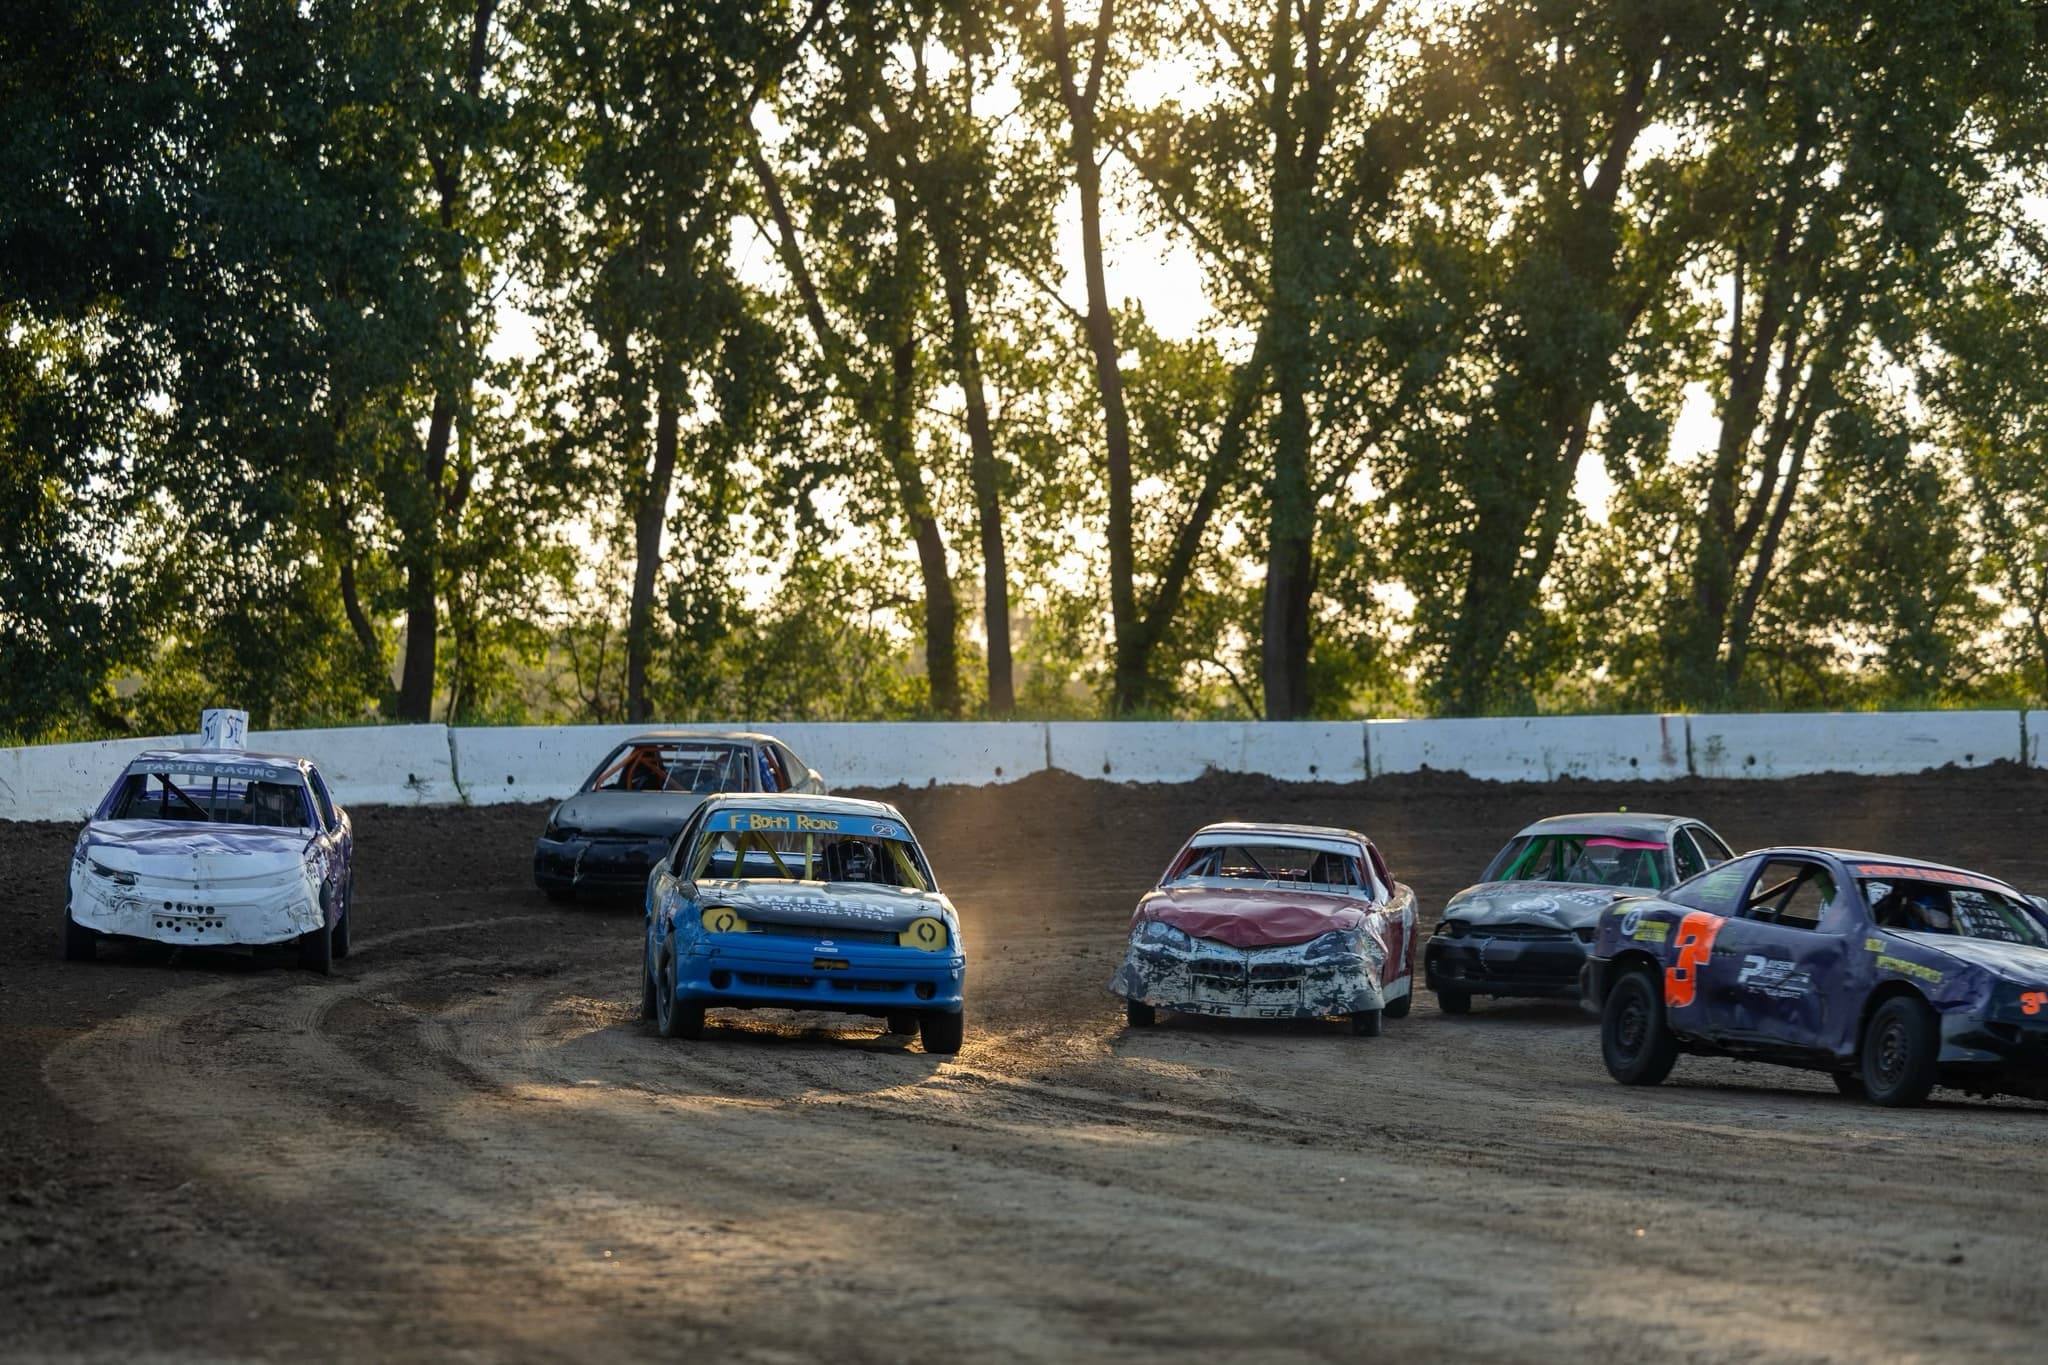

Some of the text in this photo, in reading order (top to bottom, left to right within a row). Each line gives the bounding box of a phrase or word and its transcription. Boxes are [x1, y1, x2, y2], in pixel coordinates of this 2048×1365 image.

[145, 763, 278, 779] TARTER RACING
[756, 895, 895, 913] WIDEN
